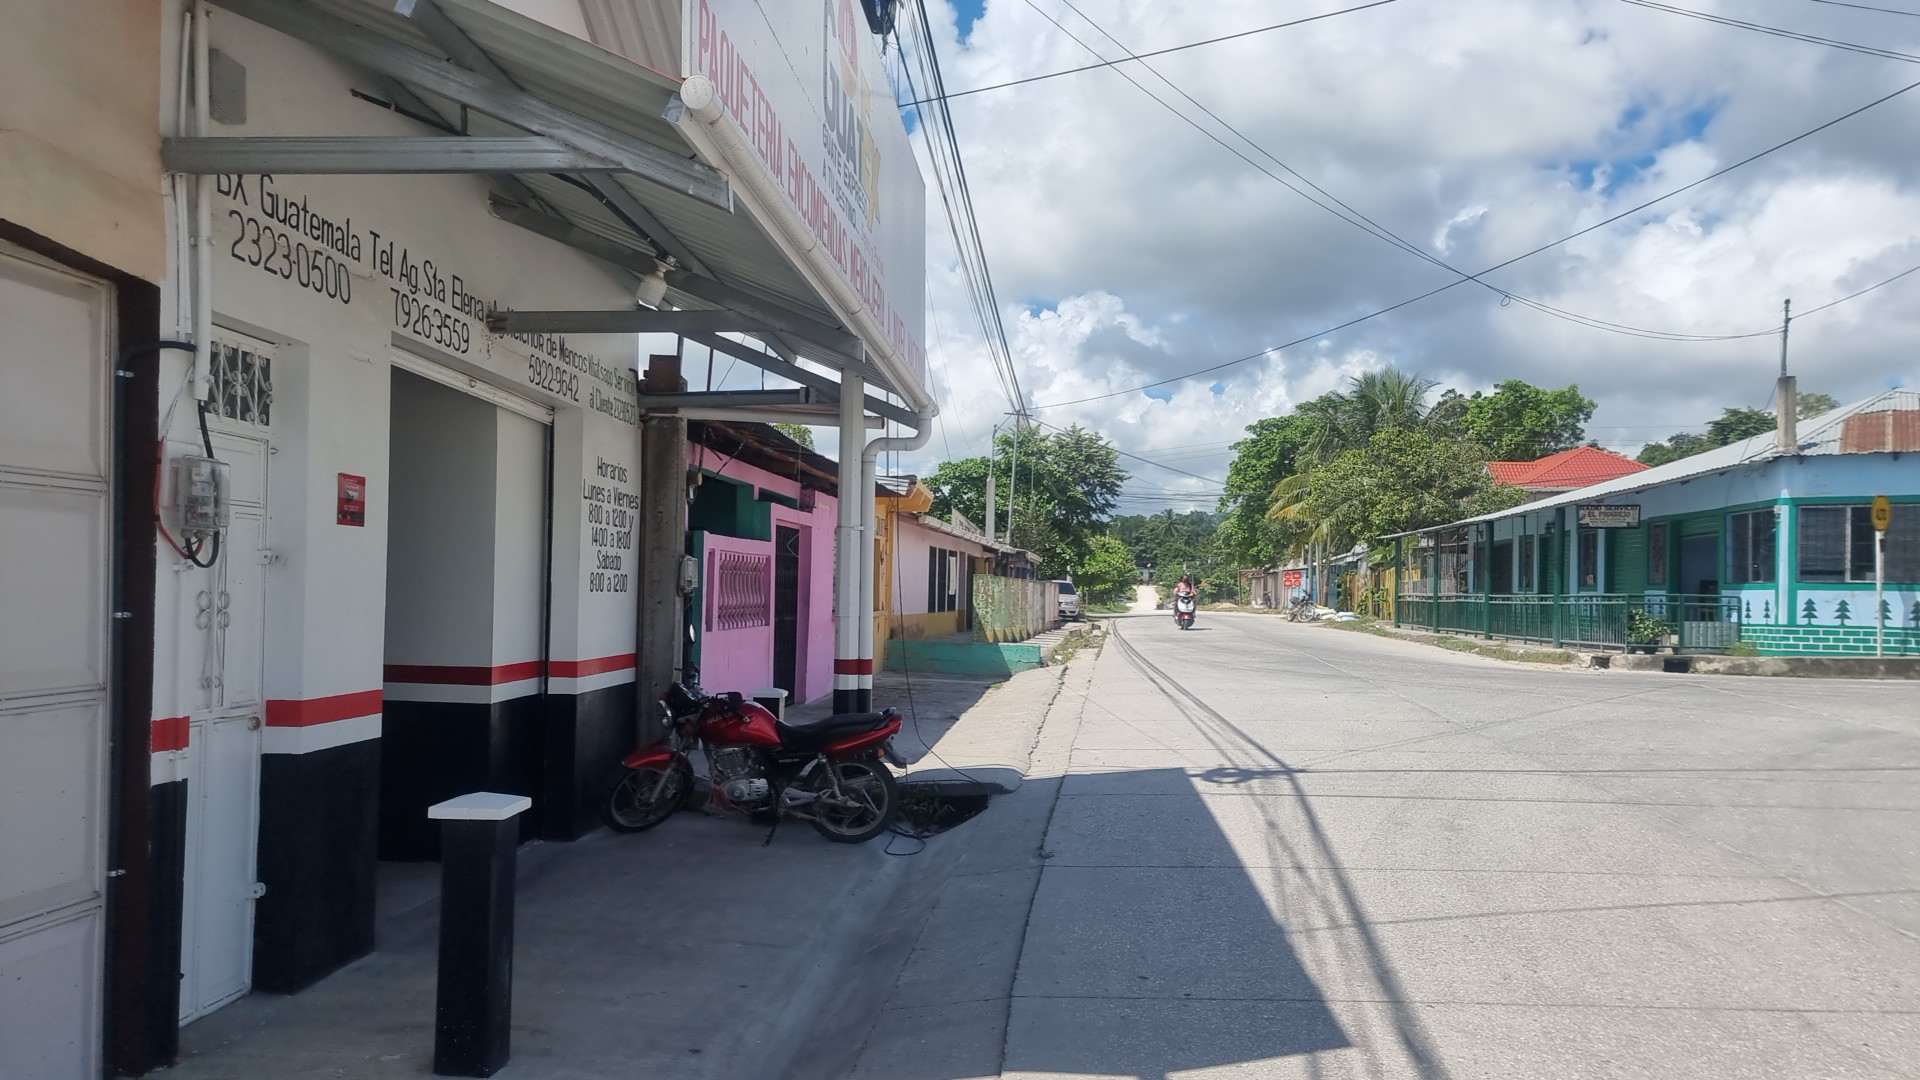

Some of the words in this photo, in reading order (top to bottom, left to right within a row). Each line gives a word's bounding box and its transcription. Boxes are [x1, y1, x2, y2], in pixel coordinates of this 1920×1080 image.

[828, 165, 834, 195] TU
[228, 209, 351, 305] 2323-0500
[260, 174, 361, 263] Guatemala
[369, 230, 394, 280] Tel
[452, 274, 485, 324] Elena
[546, 333, 557, 359] de
[559, 335, 588, 374] Mencos
[390, 287, 470, 354] 7926-3559
[528, 354, 580, 403] 5922-9642
[596, 456, 628, 484] Horarios
[583, 478, 606, 504] Lunes
[606, 488, 611, 504] a
[613, 486, 639, 510] Viernes
[606, 510, 610, 526] a
[628, 514, 634, 533] y
[610, 532, 615, 548] a
[596, 549, 622, 571] Sabado
[606, 576, 611, 593] a
